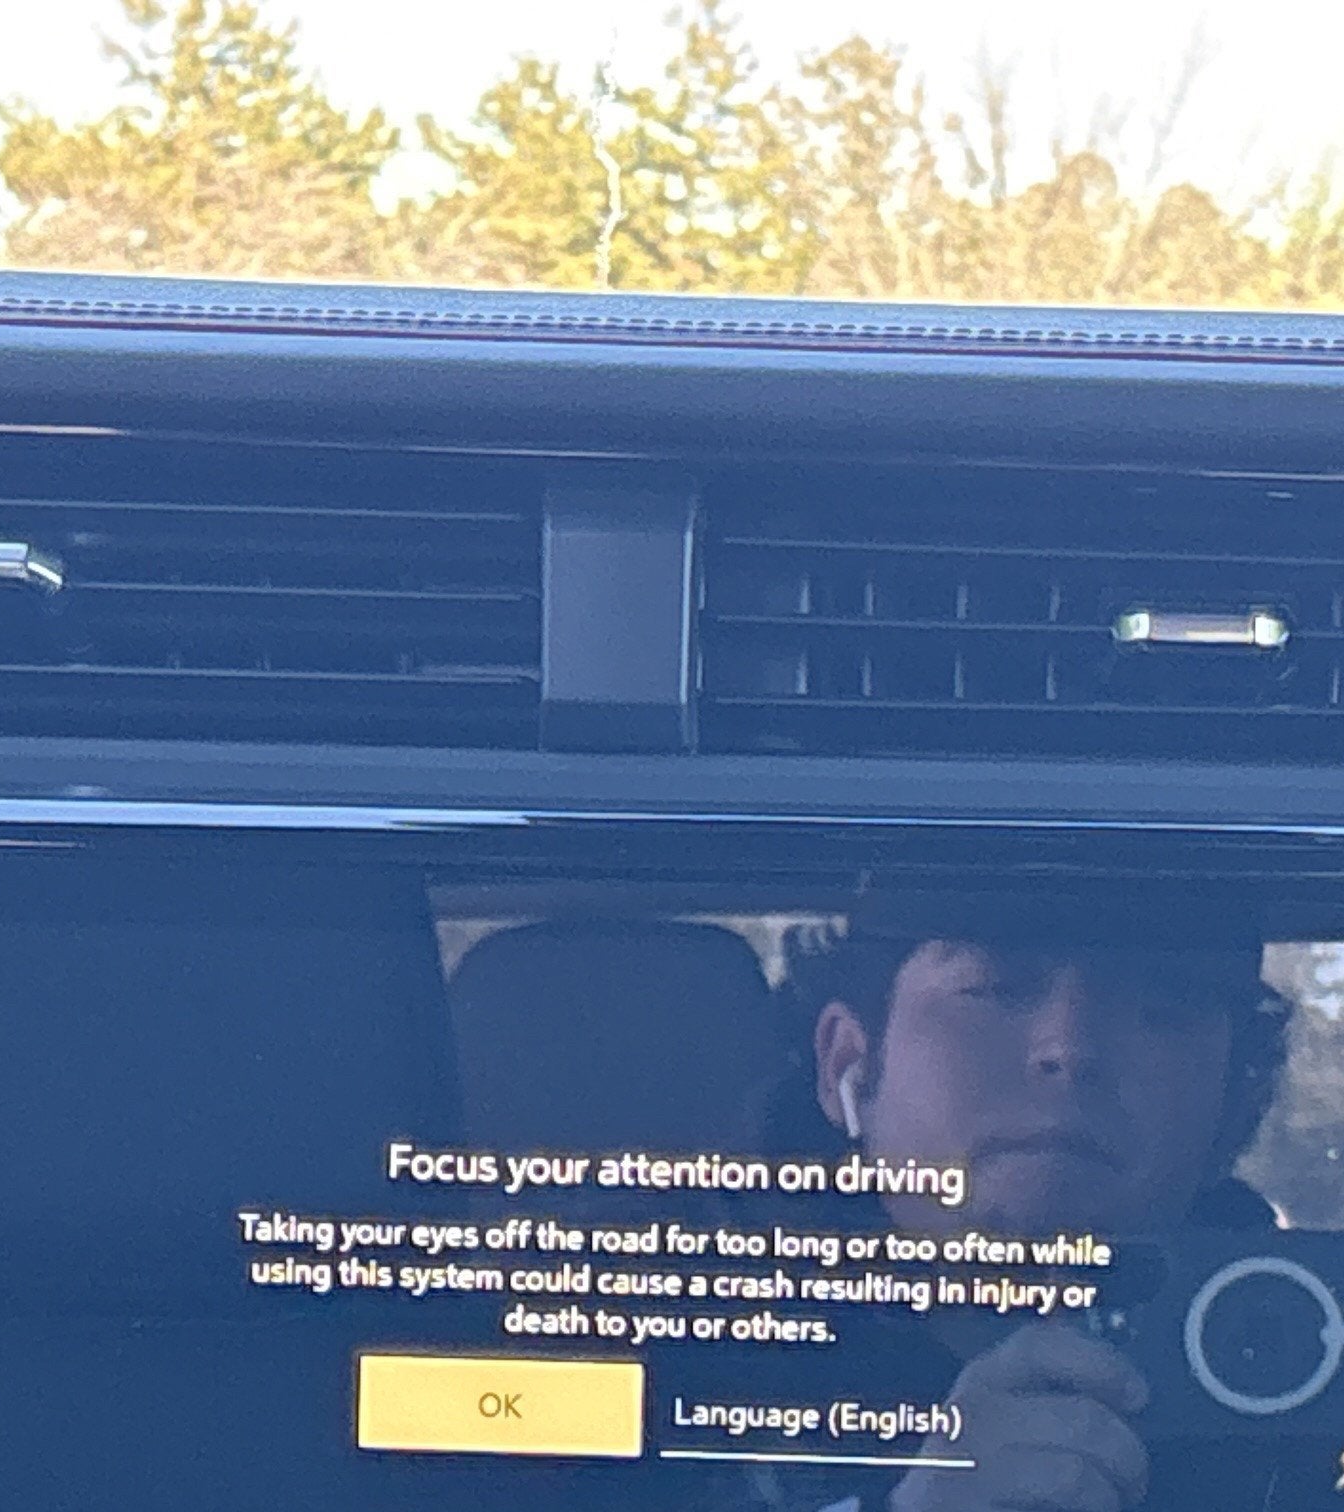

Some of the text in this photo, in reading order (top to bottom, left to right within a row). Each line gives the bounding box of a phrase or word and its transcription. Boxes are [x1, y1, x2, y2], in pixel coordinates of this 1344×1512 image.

[388, 1143, 965, 1205] Focus your attention on driving
[238, 1212, 1112, 1266] Taking your eyes off the road for too long or too often while
[251, 1256, 1097, 1315] using this system could cause a crash resulting in injury or
[504, 1303, 836, 1344] death to you or others.
[478, 1391, 522, 1419] OK
[675, 1397, 962, 1441] Language (English)
